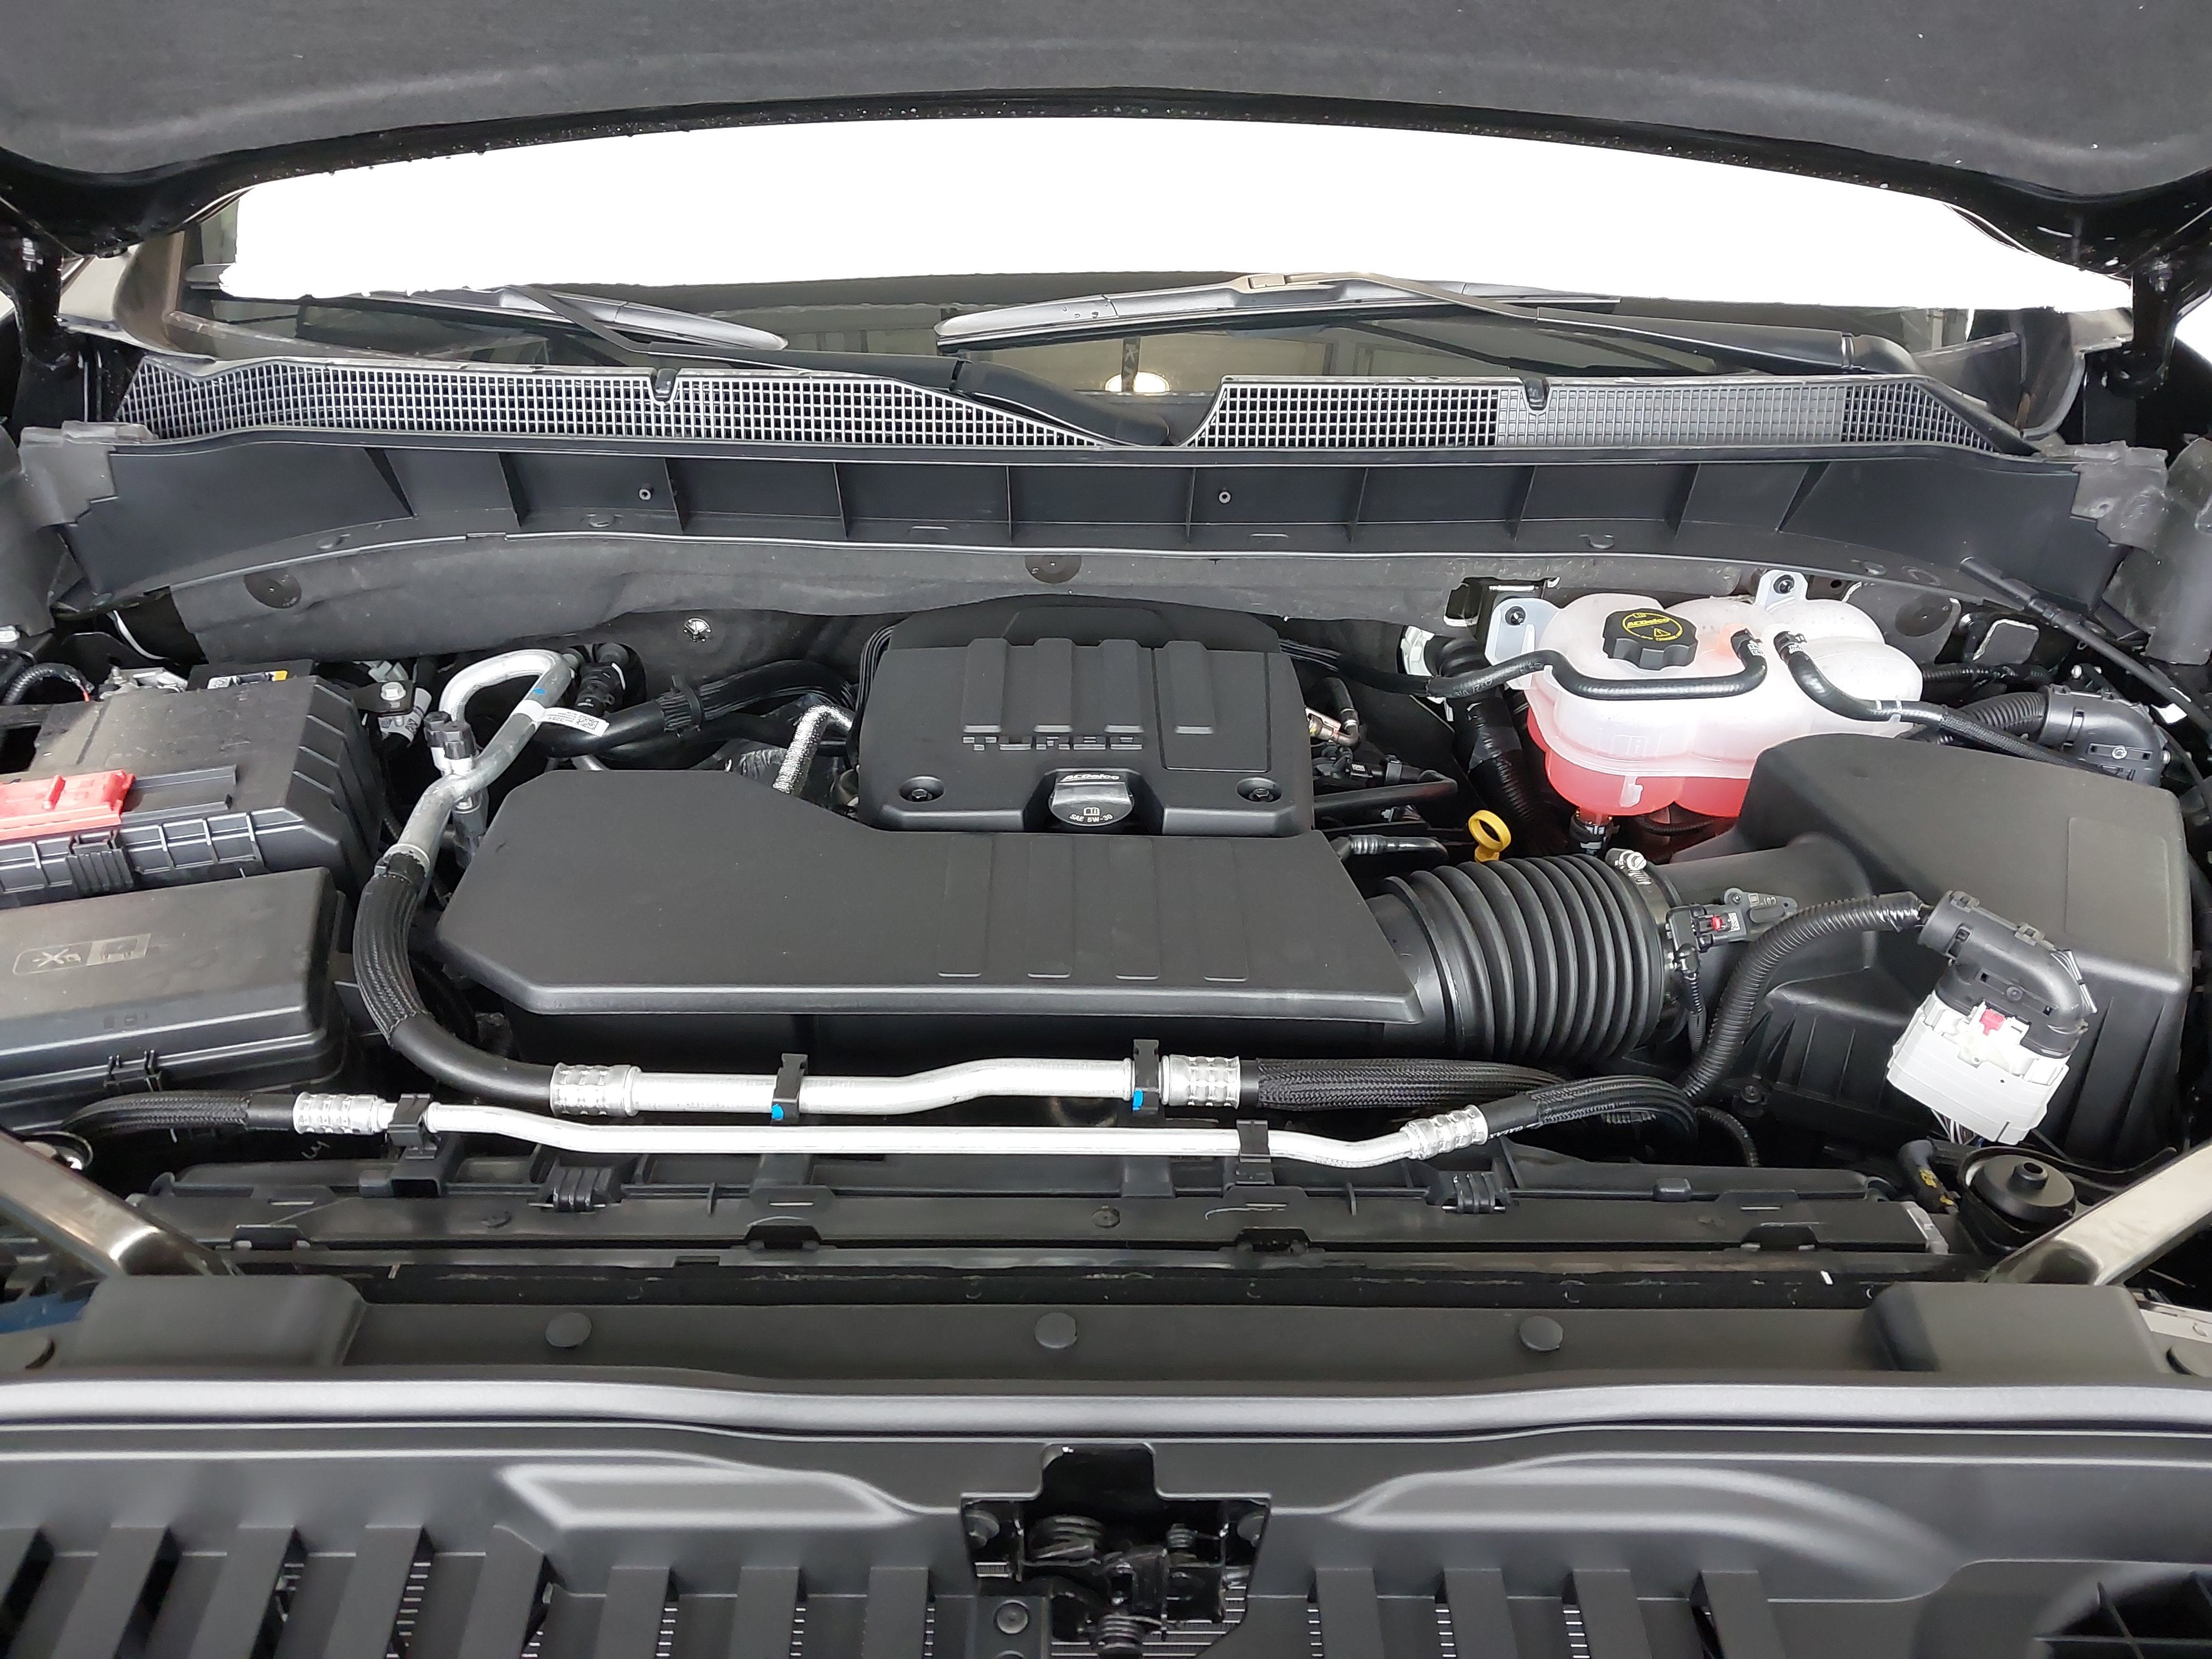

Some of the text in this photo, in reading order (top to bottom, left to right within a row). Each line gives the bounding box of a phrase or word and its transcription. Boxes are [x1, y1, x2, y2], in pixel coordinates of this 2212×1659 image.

[1059, 773, 1120, 782] ACDelco
[1069, 813, 1113, 822] SAE 5W-30
